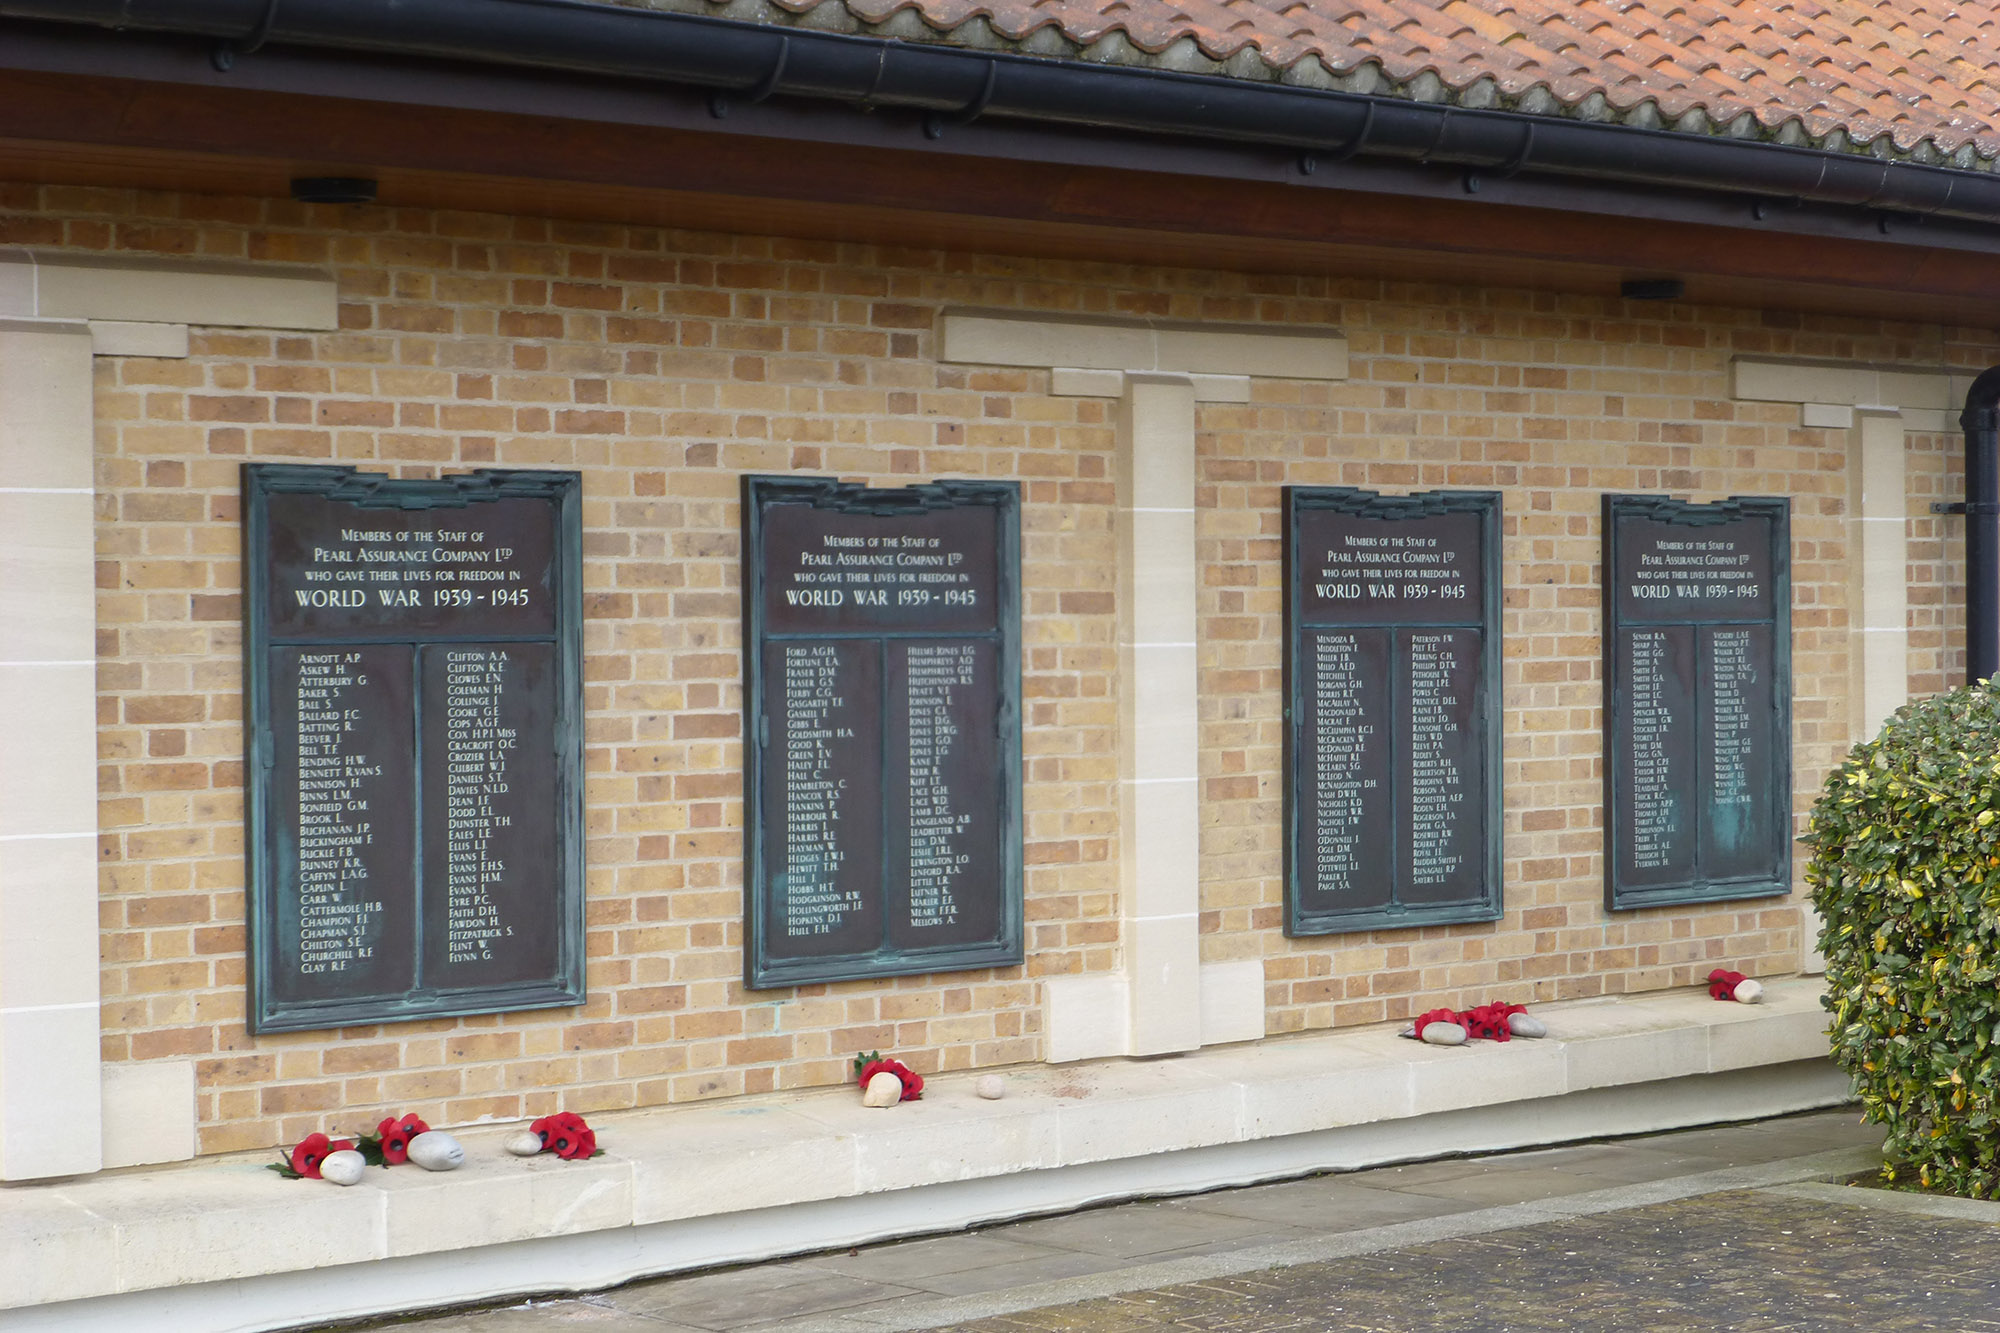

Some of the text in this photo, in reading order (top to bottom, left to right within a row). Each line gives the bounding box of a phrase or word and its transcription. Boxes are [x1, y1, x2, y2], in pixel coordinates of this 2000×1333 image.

[341, 529, 484, 541] MEMBERS OF THE STAFF OF
[824, 536, 940, 547] MEMBERS OF THE STAFF OF
[1345, 536, 1436, 546] MEMBERS OF THE STAFF OF
[314, 548, 352, 562] PEARL
[357, 548, 428, 562] ASSURANCE
[433, 548, 490, 562] COMPANY
[801, 552, 832, 565] PEARL
[836, 552, 893, 565] ASSURANCE
[897, 553, 943, 566] COMPANY
[1328, 551, 1351, 562] PEARL
[1355, 551, 1400, 563] ASSURANCE
[1403, 551, 1440, 563] COMPANY
[305, 571, 520, 581] WHO GAVE THEIR LIVES FOR FREEDOM IN
[794, 573, 968, 582] WHO GAVE THEIR LIVES FOR FREEDOM IN
[1322, 569, 1339, 577] WHO
[1342, 569, 1360, 577] GAVE
[1363, 569, 1382, 578] THEIR
[1385, 570, 1402, 578] LIVES
[1405, 570, 1417, 578] FOR
[1420, 570, 1449, 578] FREEDOM
[1316, 584, 1360, 598] WORLD
[1369, 584, 1396, 598] WAR
[1404, 585, 1428, 598] 1939
[1441, 585, 1465, 598] 1945
[296, 590, 365, 607] WORLD
[379, 590, 421, 607] WAR
[434, 590, 471, 606] 1939
[492, 590, 529, 606] 1945
[786, 590, 843, 606] WORLD
[854, 590, 888, 605] WAR
[899, 590, 928, 605] 1939
[945, 590, 976, 605] 1945
[446, 651, 485, 662] CLIFTON
[786, 657, 821, 667] FORTUNE
[298, 676, 353, 686] ATTERBURY
[447, 673, 480, 684] CLOWES
[297, 688, 328, 698] BAKER
[298, 711, 340, 721] BALLARD
[787, 729, 832, 740] GOLDSMITH
[787, 771, 808, 782] HALL
[299, 791, 329, 801] BINNS
[299, 802, 344, 813] BONFIELD
[910, 807, 932, 818] LAMB
[787, 812, 827, 822] HARBOUR
[448, 818, 490, 829] DUNSTER
[299, 859, 340, 870] BUNNEY
[448, 863, 477, 873] EVANS
[787, 864, 817, 874] HEWITT
[299, 871, 337, 882] CAFFYN
[910, 867, 942, 877] LINFORD
[448, 874, 477, 885] EVANS
[910, 887, 938, 897] LUTNER
[448, 896, 470, 907] EYRE
[300, 904, 360, 916] CATTERMOLE
[910, 917, 943, 927] MELLOWS
[448, 928, 502, 940] FITZPATRICK
[449, 952, 477, 962] FLYNN
